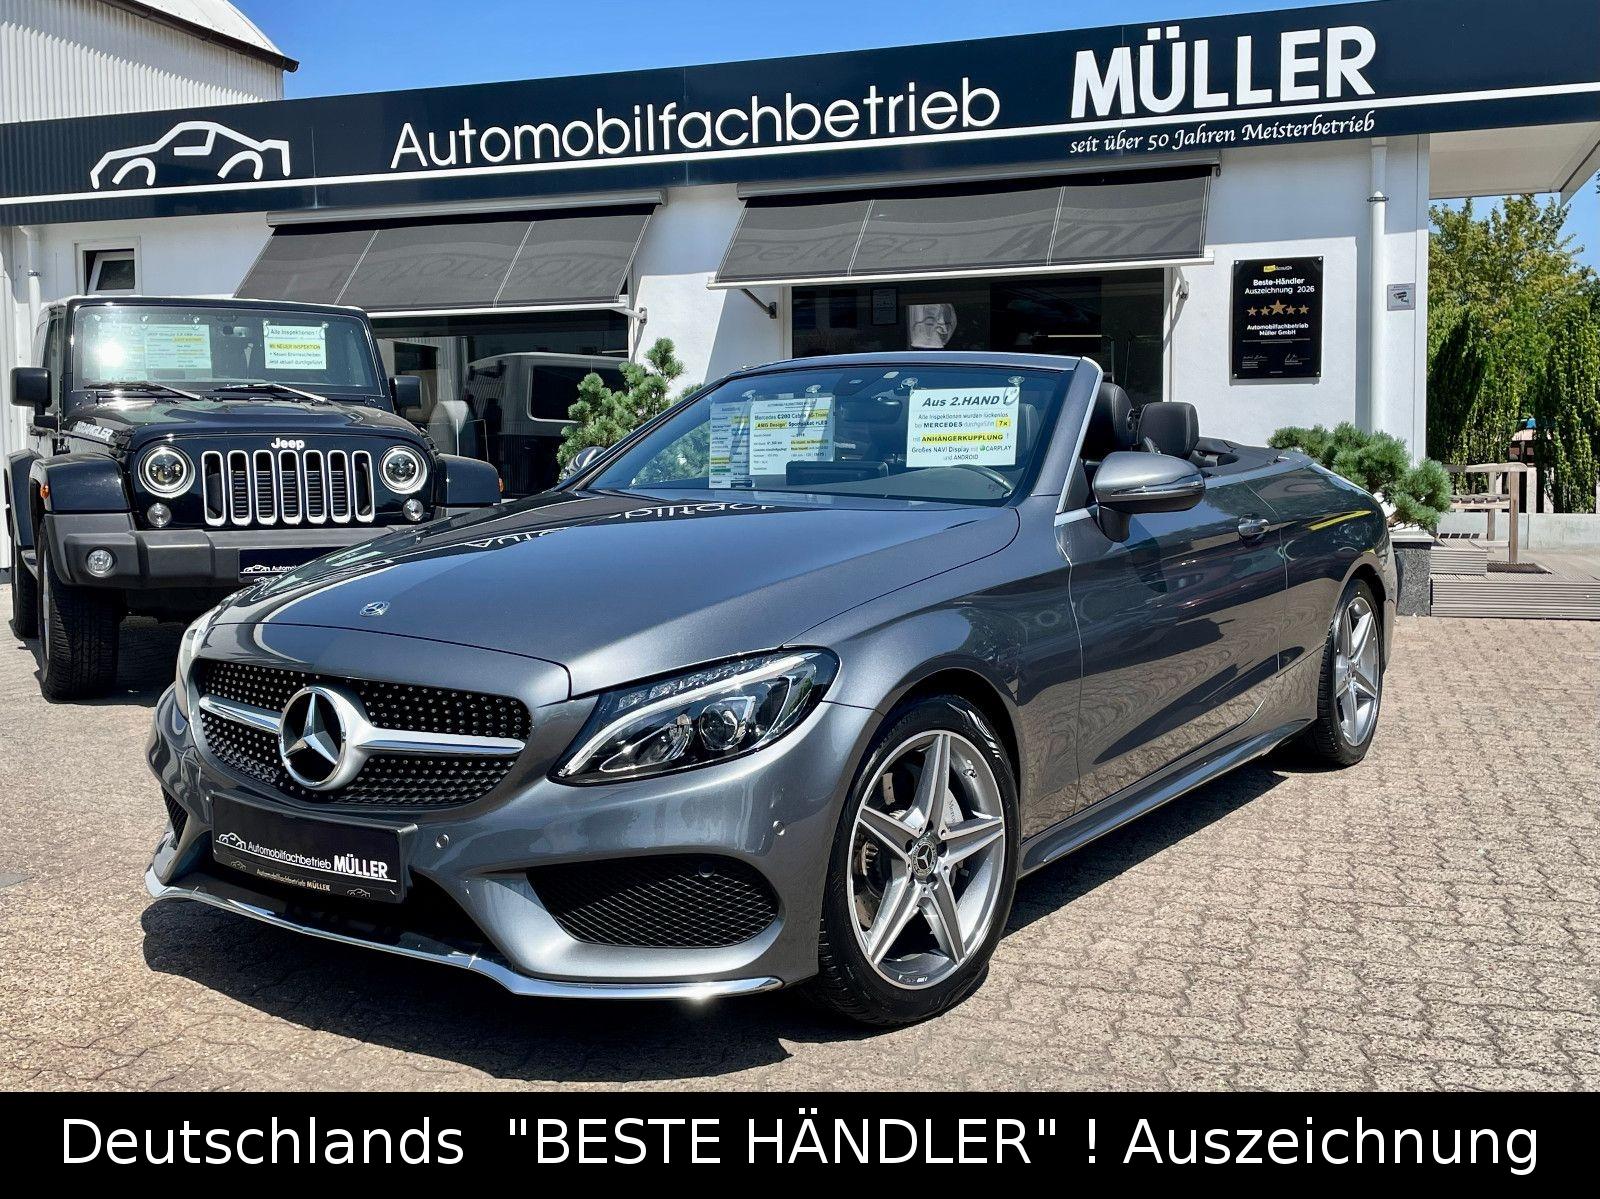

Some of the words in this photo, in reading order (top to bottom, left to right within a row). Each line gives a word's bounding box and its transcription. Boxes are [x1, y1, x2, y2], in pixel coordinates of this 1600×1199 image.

[391, 77, 1001, 169] Automobilfachbetrieb
[1070, 25, 1377, 119] MÜLLER
[1069, 135, 1100, 154] seit
[1103, 129, 1144, 151] über
[1147, 133, 1169, 152] 50
[1171, 122, 1237, 150] Jahren
[1241, 110, 1376, 142] Meisterbetrieb
[1252, 277, 1305, 287] Beste-Händler
[1244, 286, 1293, 295] Auszeichnung
[1296, 285, 1315, 293] 2026
[1246, 323, 1309, 331] Automobilfachbetrieb
[921, 397, 946, 407] Aus
[949, 395, 1000, 406] 2.HAND
[270, 437, 305, 450] Jeep
[921, 433, 1004, 442] ANHÄNGERKUPPLUNG
[247, 841, 332, 870] Automobilfachbetrieb
[333, 853, 388, 879] MÜLLER
[306, 880, 331, 892] MÜLLER
